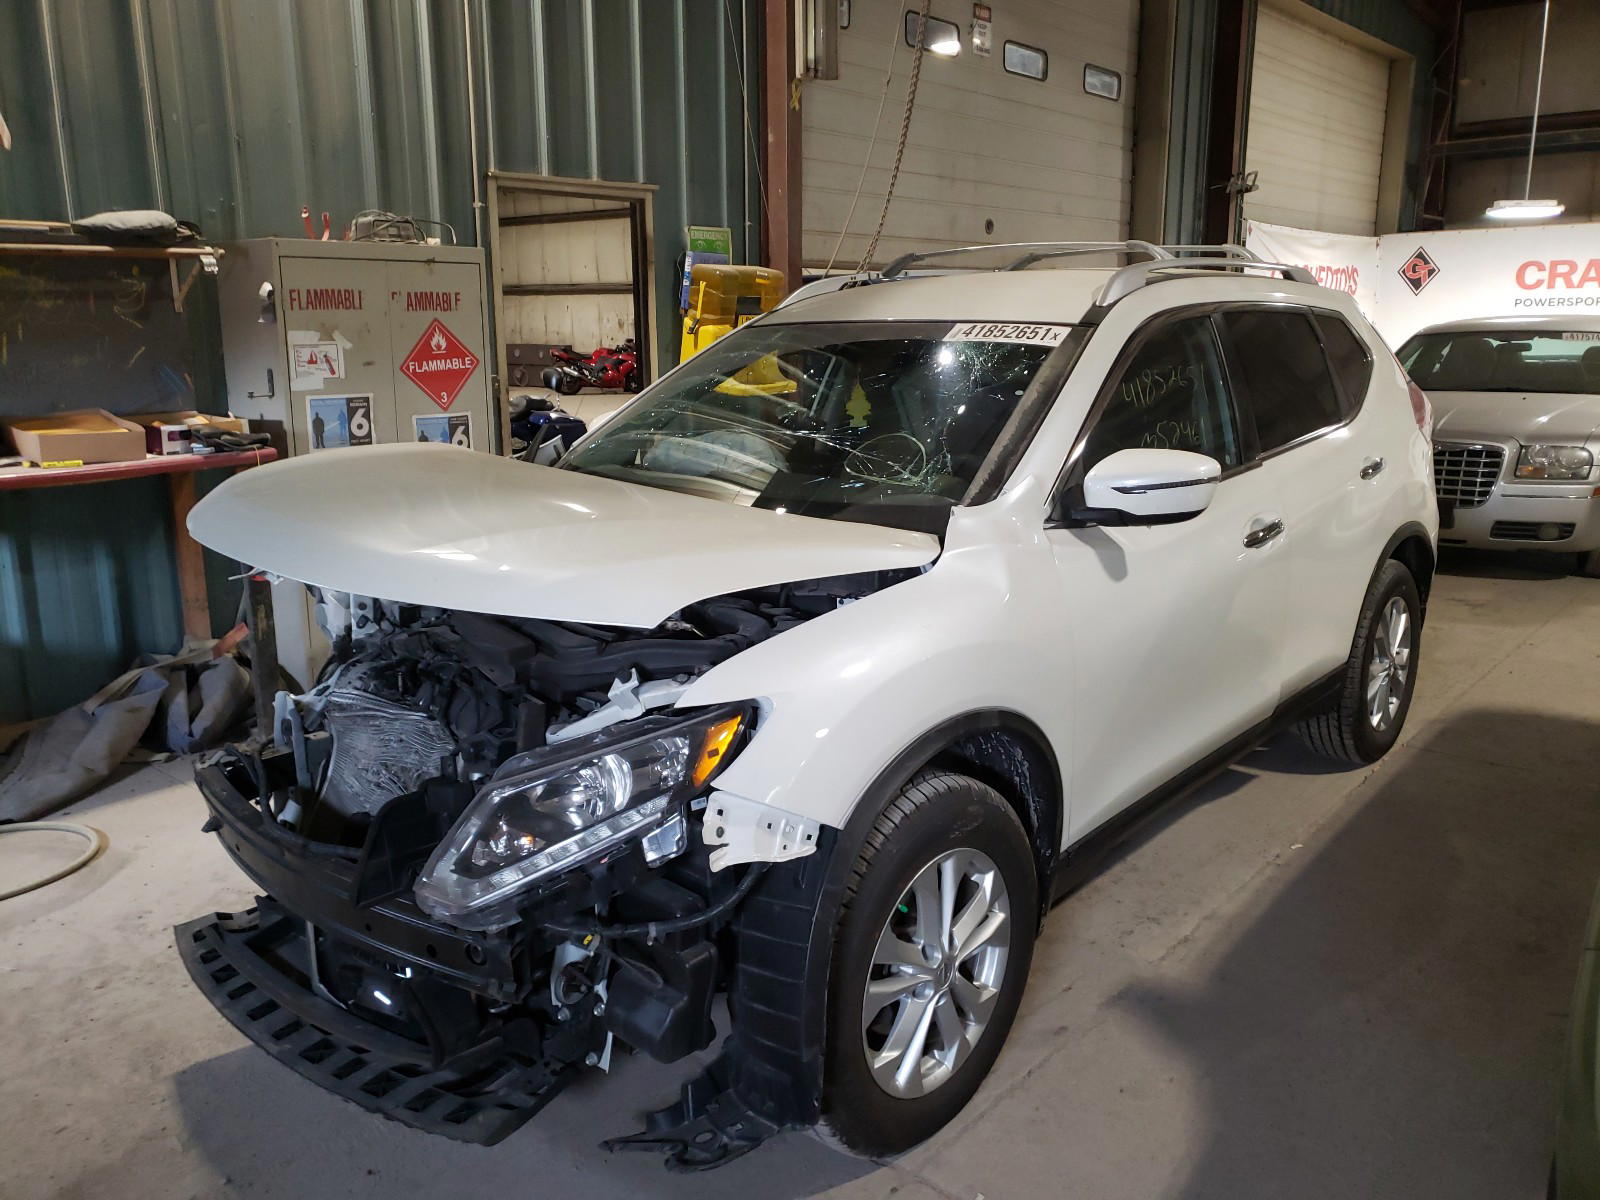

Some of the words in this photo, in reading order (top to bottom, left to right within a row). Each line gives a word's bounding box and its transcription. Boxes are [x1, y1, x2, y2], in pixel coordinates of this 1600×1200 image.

[408, 356, 472, 374] FLAMMABLE
[440, 391, 448, 403] 3
[350, 408, 370, 438] 6
[450, 425, 469, 449] 6
